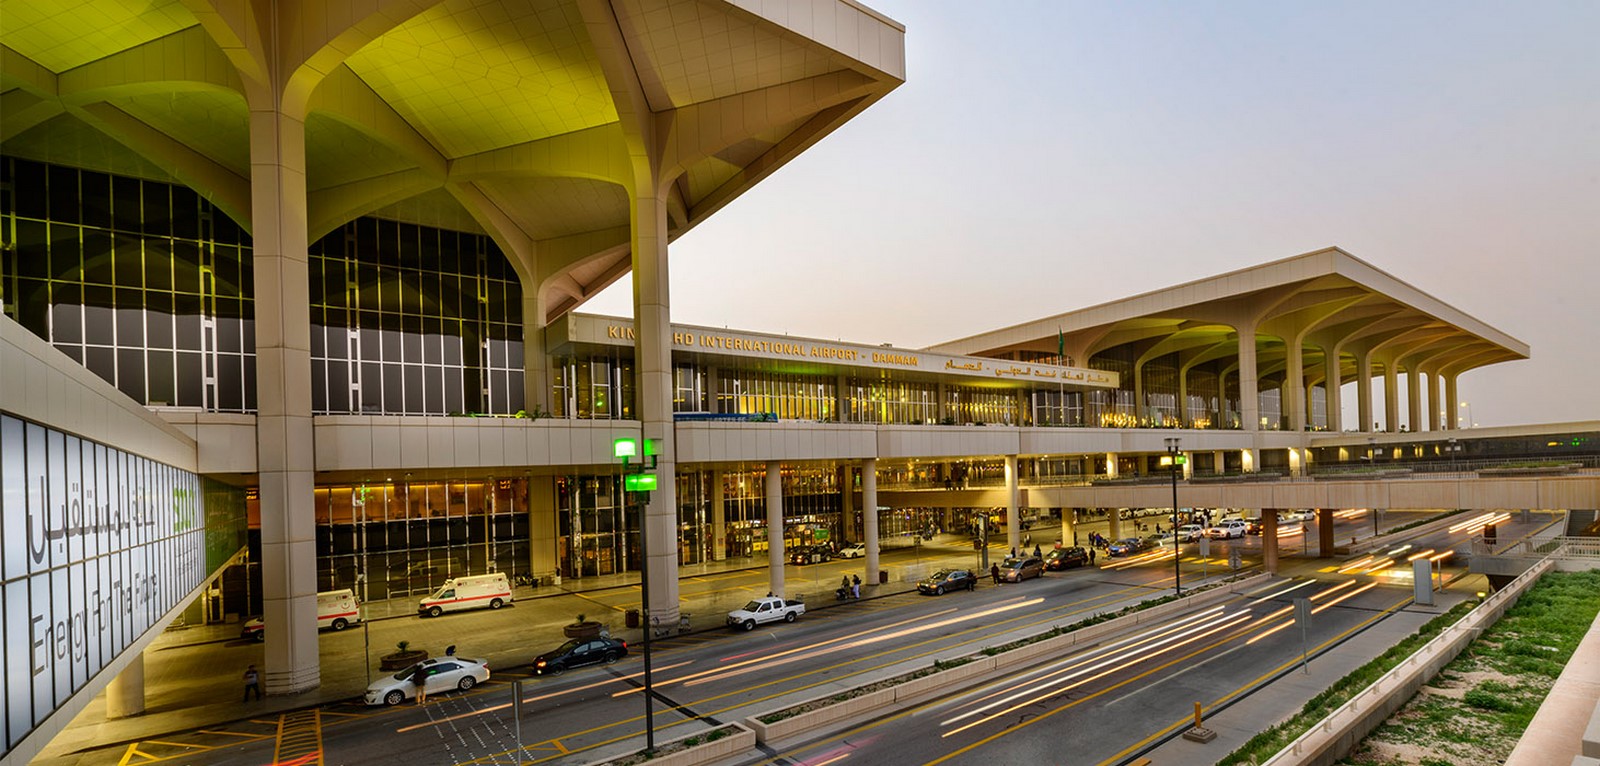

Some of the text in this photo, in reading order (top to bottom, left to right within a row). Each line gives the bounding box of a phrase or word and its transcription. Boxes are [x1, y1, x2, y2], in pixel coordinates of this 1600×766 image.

[608, 325, 635, 340] KIN
[673, 331, 695, 347] HD
[699, 334, 807, 357] INTERNATIONAL
[810, 346, 858, 361] AIRPORT
[872, 351, 919, 367] DAMMAM
[31, 608, 88, 677] Energy
[91, 589, 112, 637] For
[113, 579, 132, 621] The
